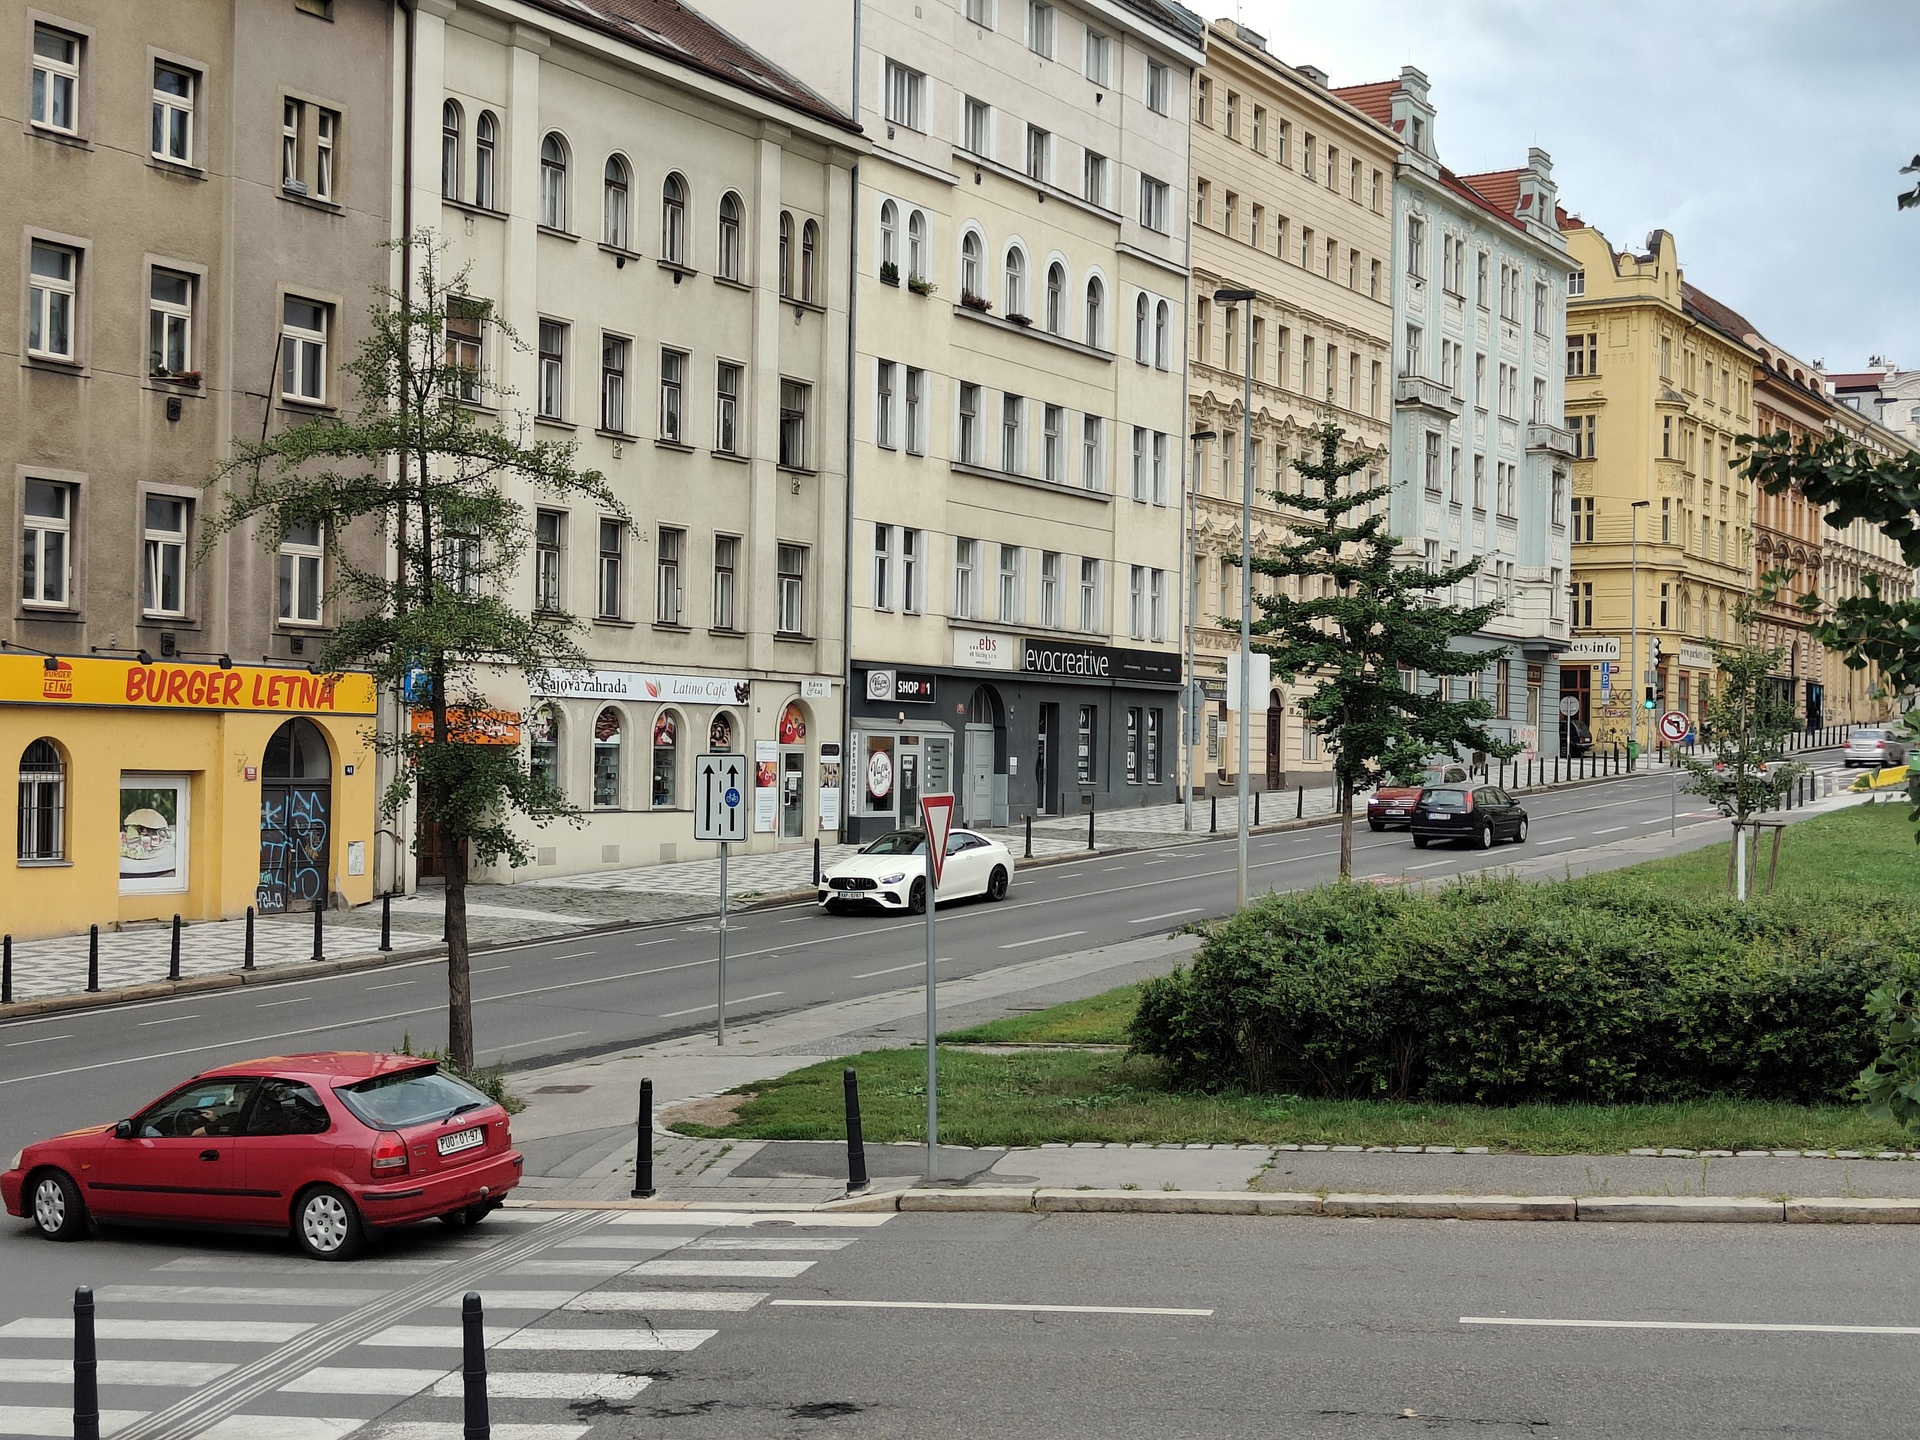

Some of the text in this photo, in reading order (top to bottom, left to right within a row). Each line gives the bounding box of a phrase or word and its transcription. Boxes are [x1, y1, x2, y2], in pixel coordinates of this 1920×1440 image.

[1026, 648, 1109, 676] evocreative
[126, 667, 243, 706] BURGER
[583, 676, 627, 694] zahrada
[673, 680, 728, 702] Latino Café
[898, 680, 919, 694] SHOP
[459, 1129, 478, 1144] 01-97
